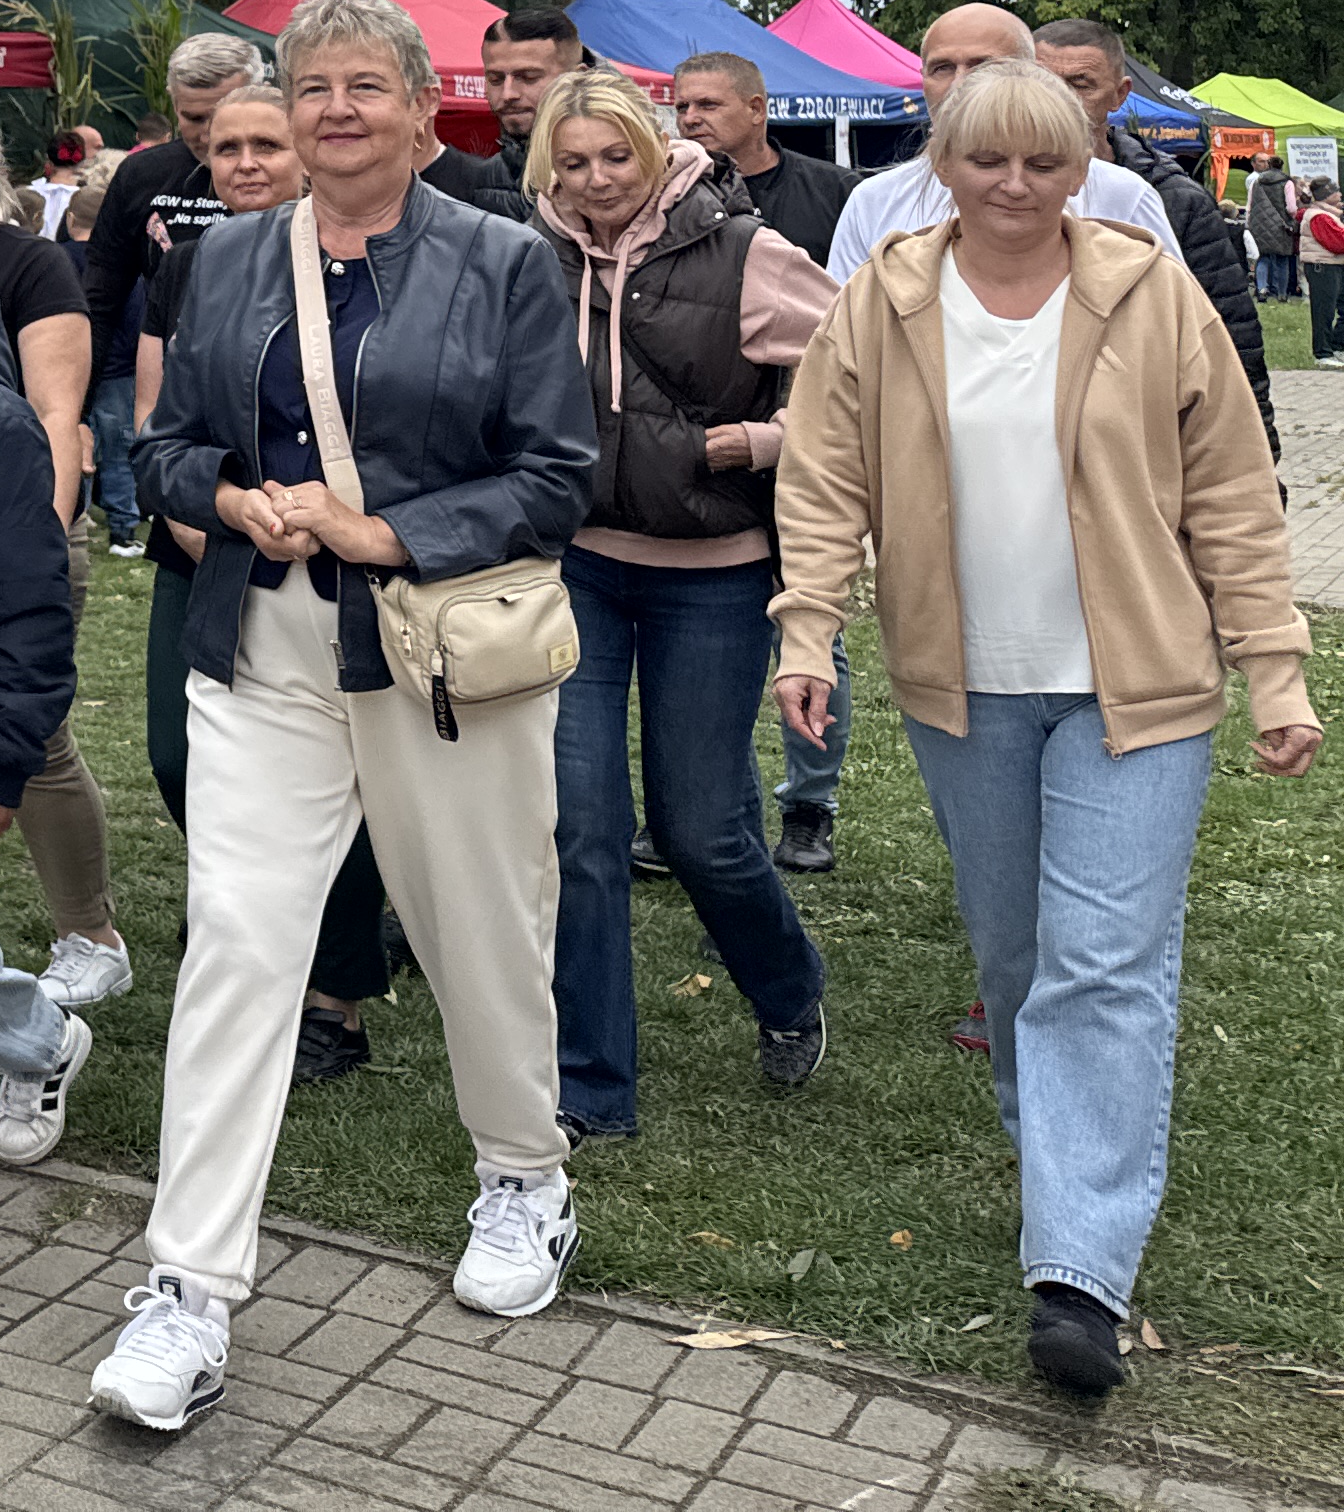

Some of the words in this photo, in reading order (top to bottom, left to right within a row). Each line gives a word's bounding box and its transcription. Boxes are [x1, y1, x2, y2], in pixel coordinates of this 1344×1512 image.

[453, 74, 486, 99] KGW
[767, 96, 790, 120] GW
[150, 194, 181, 207] KGW
[182, 199, 194, 208] w
[308, 324, 325, 381] LAURA
[317, 389, 341, 456] BIAGGI
